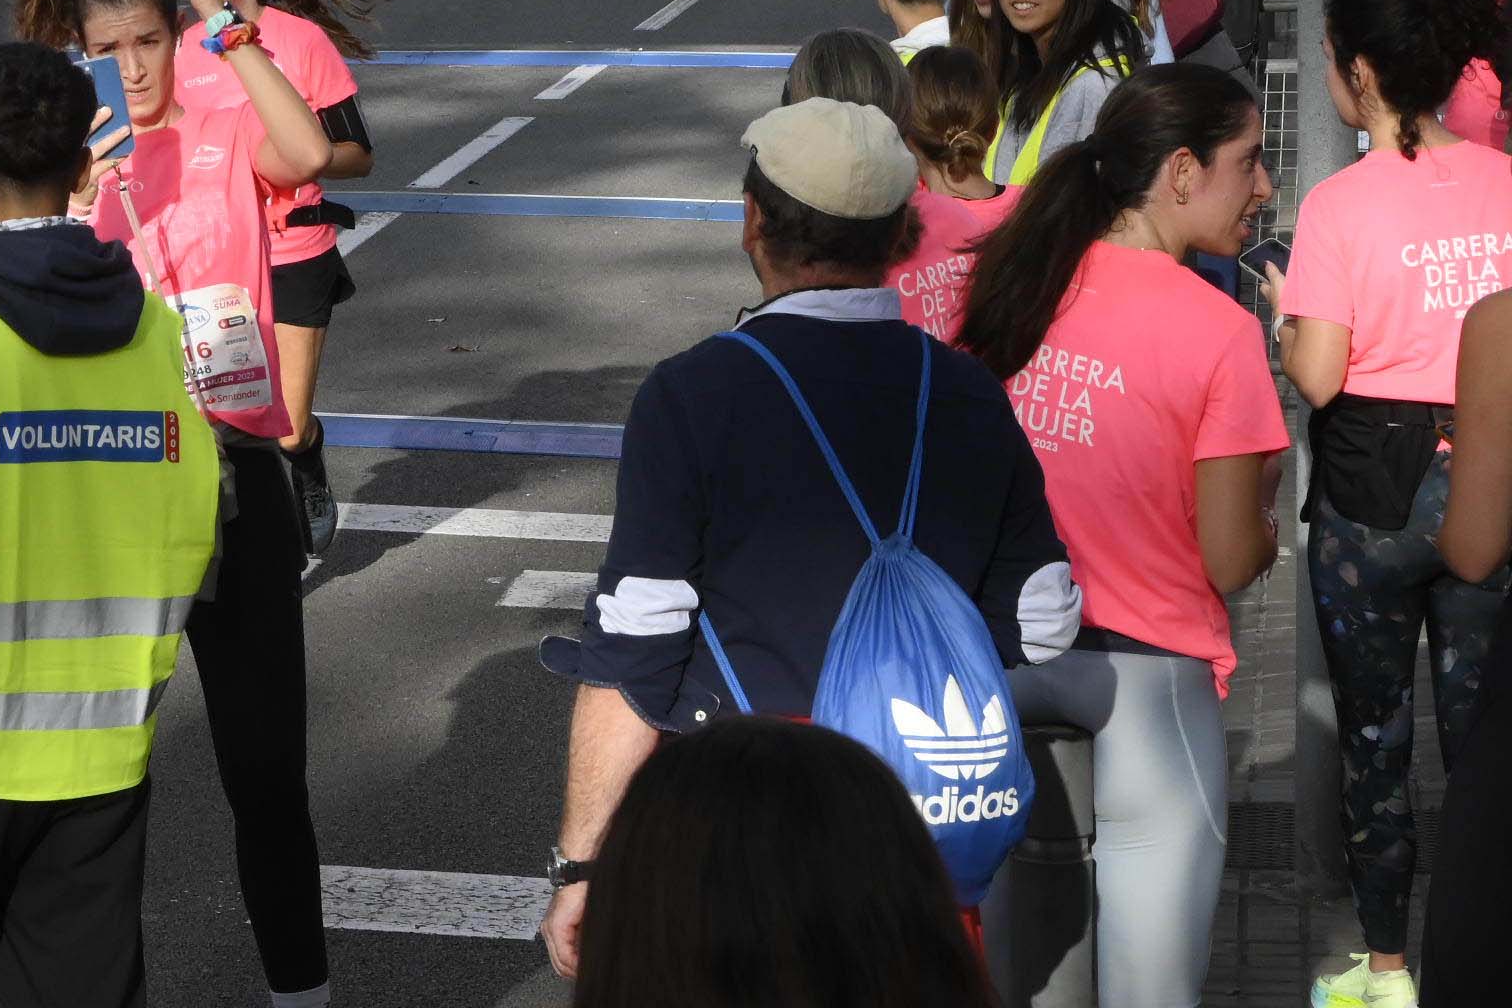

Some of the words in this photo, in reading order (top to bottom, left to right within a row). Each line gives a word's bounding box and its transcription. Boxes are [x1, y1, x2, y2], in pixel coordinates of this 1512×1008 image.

[1400, 232, 1512, 268] CARRERA
[1425, 261, 1459, 288] DE
[1466, 257, 1500, 281] LA
[213, 298, 241, 311] SUMA
[921, 288, 947, 318] DE
[183, 342, 213, 362] 16
[1028, 344, 1126, 395] RRERA
[217, 389, 261, 403] Santander
[1012, 369, 1051, 403] DE
[1058, 380, 1092, 416] LA
[2, 424, 161, 450] VOLUNTARIS
[168, 413, 177, 461] 2000
[1032, 437, 1059, 453] 2023
